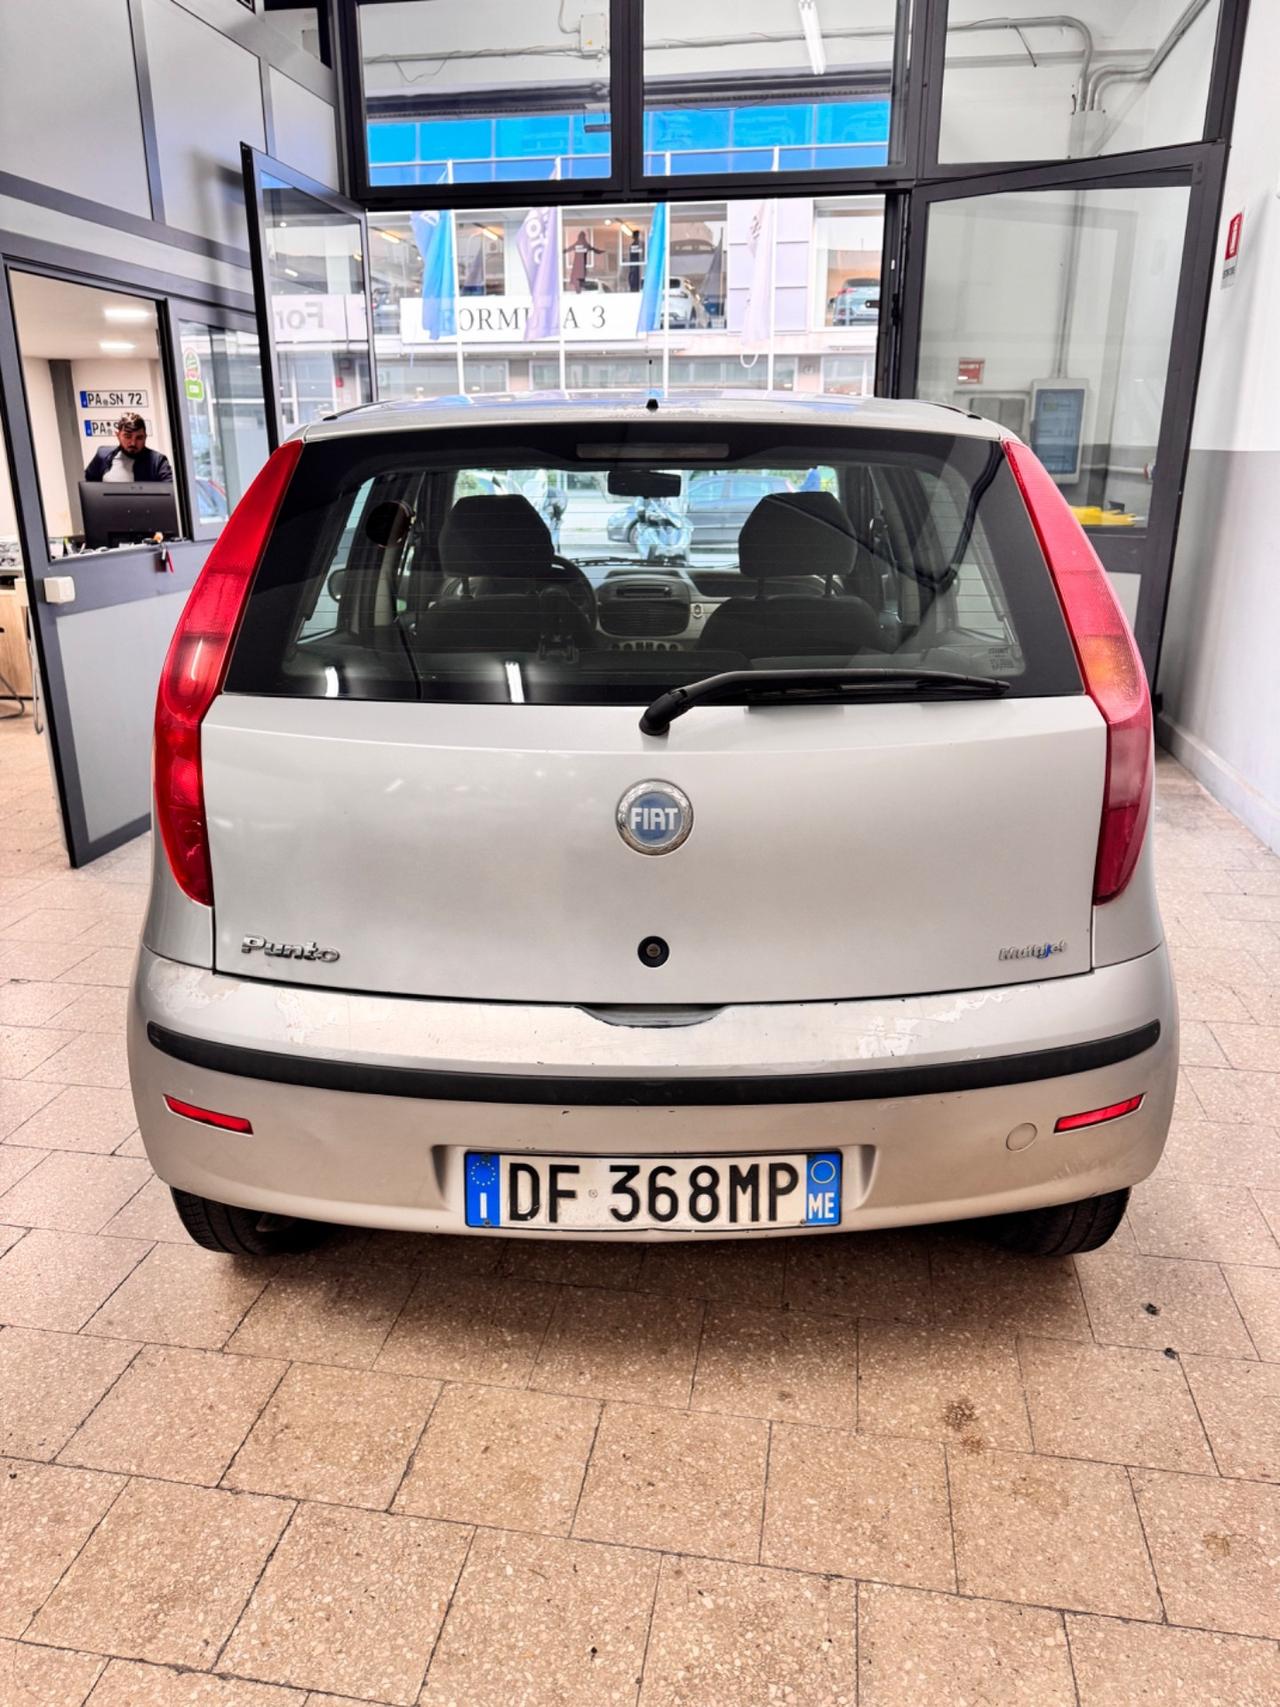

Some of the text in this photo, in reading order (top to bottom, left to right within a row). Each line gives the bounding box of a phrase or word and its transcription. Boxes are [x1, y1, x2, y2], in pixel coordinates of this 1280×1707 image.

[591, 305, 607, 329] 3
[88, 393, 142, 405] PA SN 72
[630, 807, 679, 831] FIAT
[241, 934, 340, 963] Punto
[509, 1163, 580, 1223] DF
[609, 1162, 799, 1223] 368MP
[808, 1192, 835, 1219] ME
